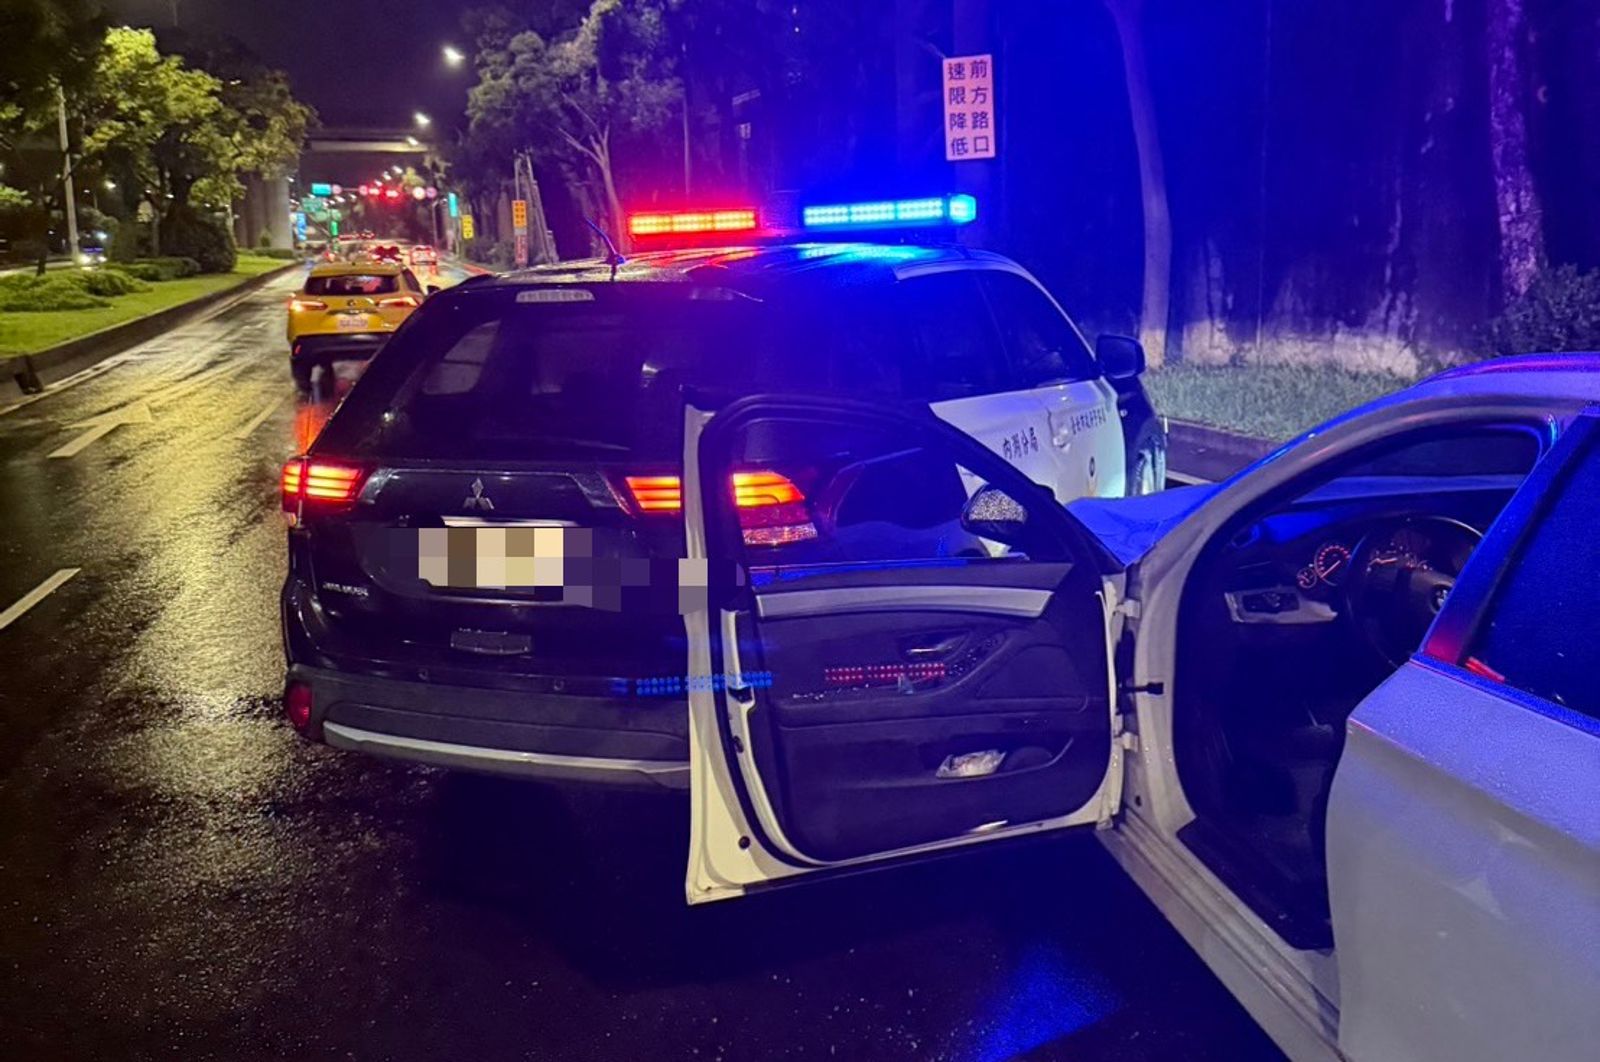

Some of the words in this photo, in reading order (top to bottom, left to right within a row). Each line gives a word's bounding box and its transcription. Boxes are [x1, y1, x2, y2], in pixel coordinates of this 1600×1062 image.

[948, 62, 968, 155] 速限降低
[970, 60, 989, 153] 前方路口
